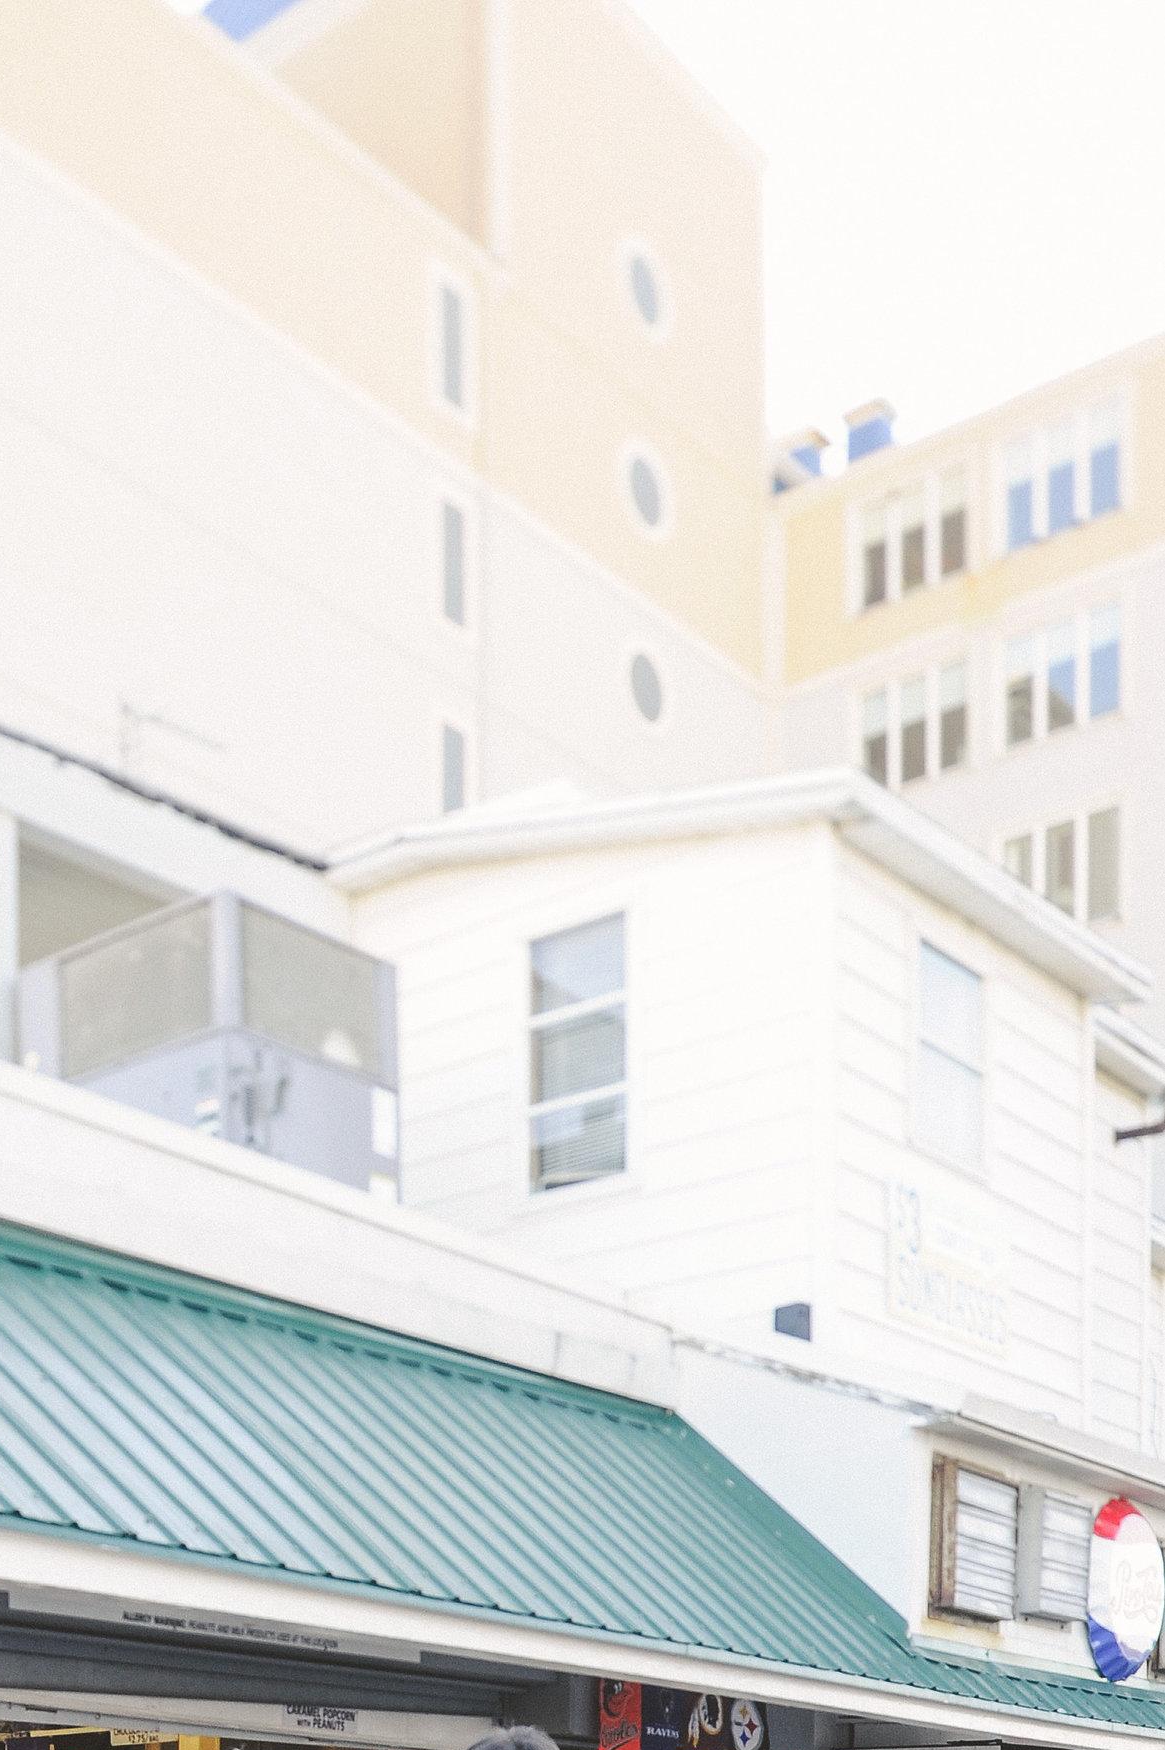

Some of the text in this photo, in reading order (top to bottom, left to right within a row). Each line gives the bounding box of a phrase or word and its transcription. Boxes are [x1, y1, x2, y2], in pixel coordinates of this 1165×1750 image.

[323, 1706, 356, 1722] POPCORN
[313, 1717, 345, 1732] PEANUTS
[646, 1725, 680, 1740] RAVENS
